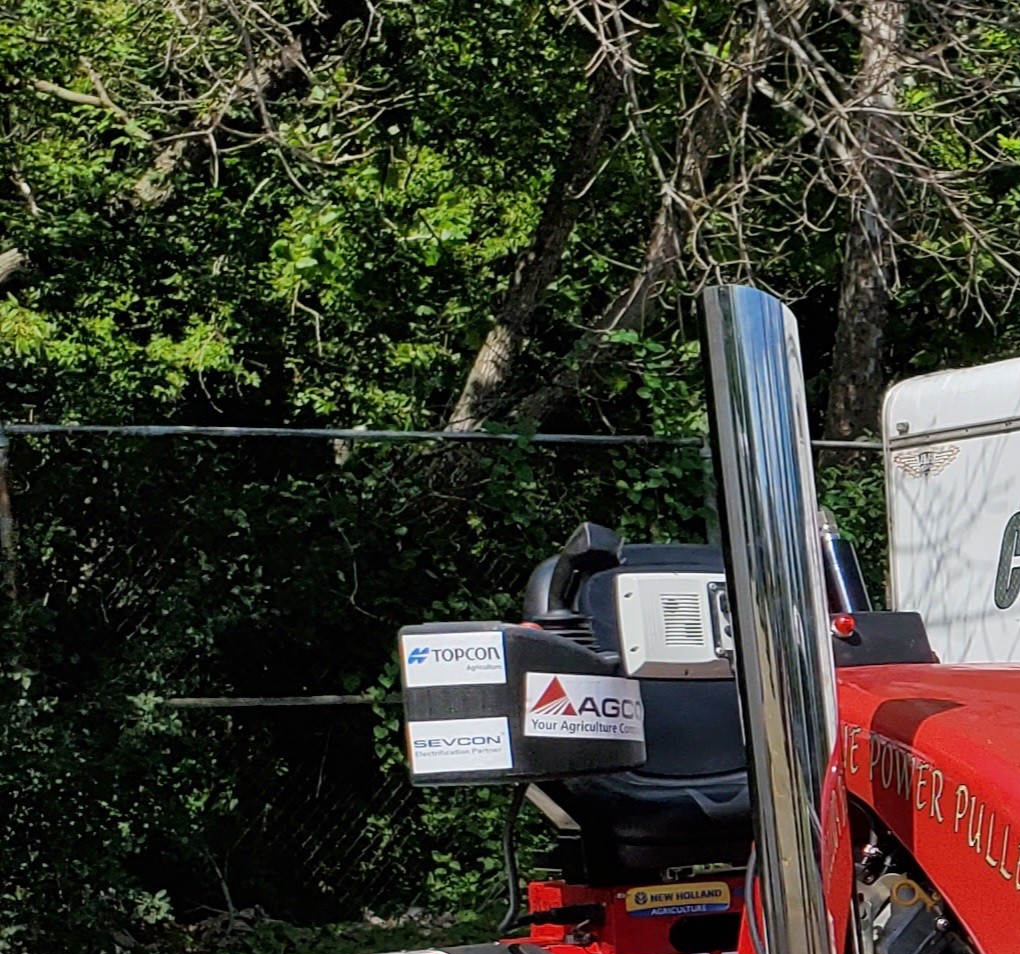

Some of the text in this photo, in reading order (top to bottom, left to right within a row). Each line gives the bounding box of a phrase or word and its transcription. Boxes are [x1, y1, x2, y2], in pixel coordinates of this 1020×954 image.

[432, 646, 501, 663] TOPCON
[531, 719, 558, 731] Your
[560, 719, 618, 734] Agriculture
[413, 736, 501, 749] SEVCON
[869, 733, 945, 823] POWER
[650, 889, 722, 903] NEW HOLLAND
[650, 904, 707, 916] AGRICULTURE
